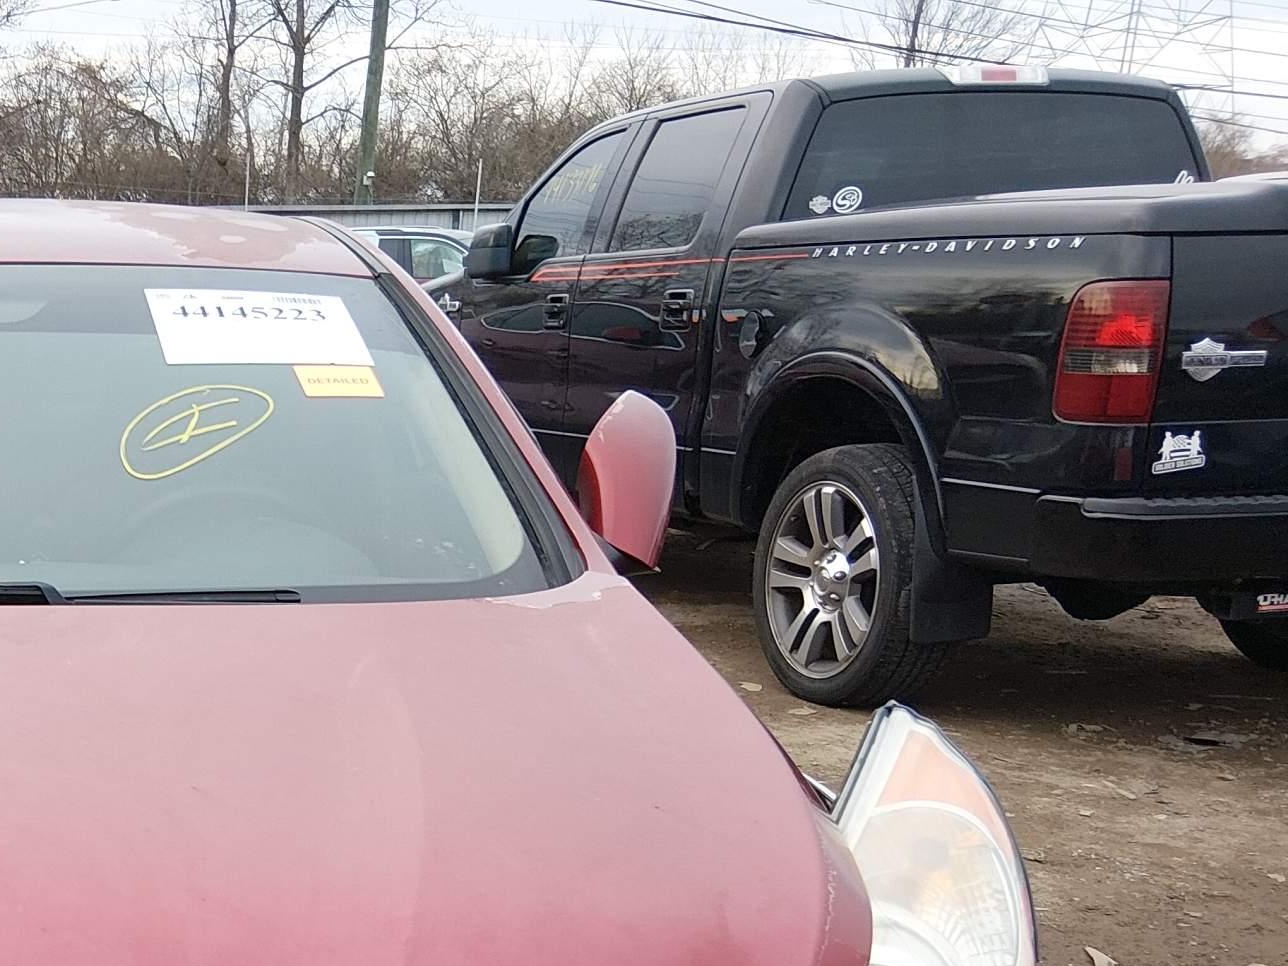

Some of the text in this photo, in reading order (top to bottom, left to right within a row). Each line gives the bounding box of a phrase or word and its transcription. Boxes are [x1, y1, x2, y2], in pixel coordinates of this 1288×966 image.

[811, 236, 1088, 258] HARLEY-DAVIDSON
[172, 305, 327, 322] 44145223
[306, 377, 370, 385] DETAILED
